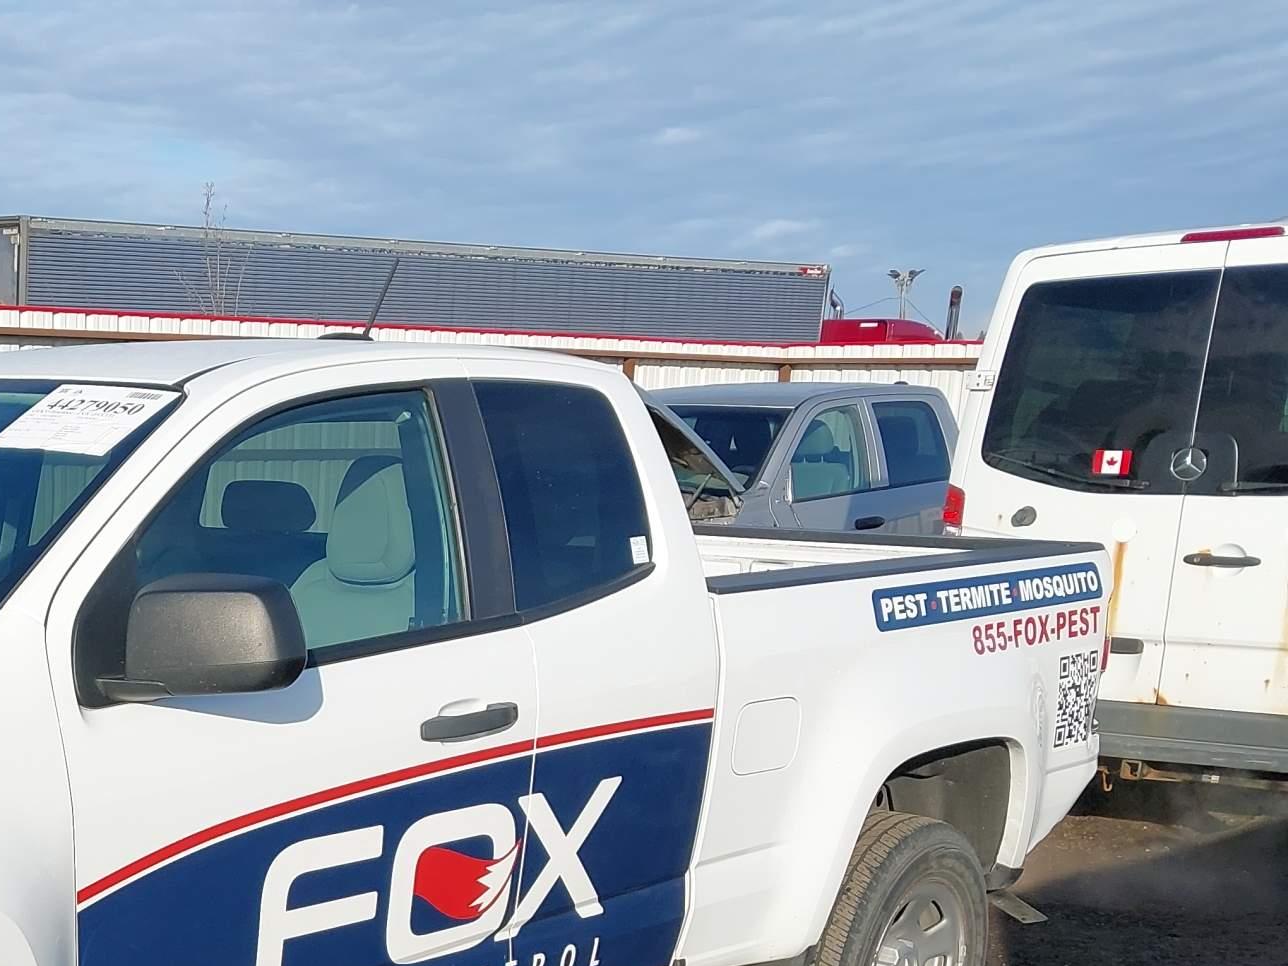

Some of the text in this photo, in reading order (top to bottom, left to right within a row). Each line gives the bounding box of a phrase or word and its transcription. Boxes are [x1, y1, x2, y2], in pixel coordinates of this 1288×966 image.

[47, 398, 145, 415] 44279050
[880, 571, 1099, 622] PEST TERMITE MOSQUITO
[972, 606, 1101, 655] 855-FOX-PEST
